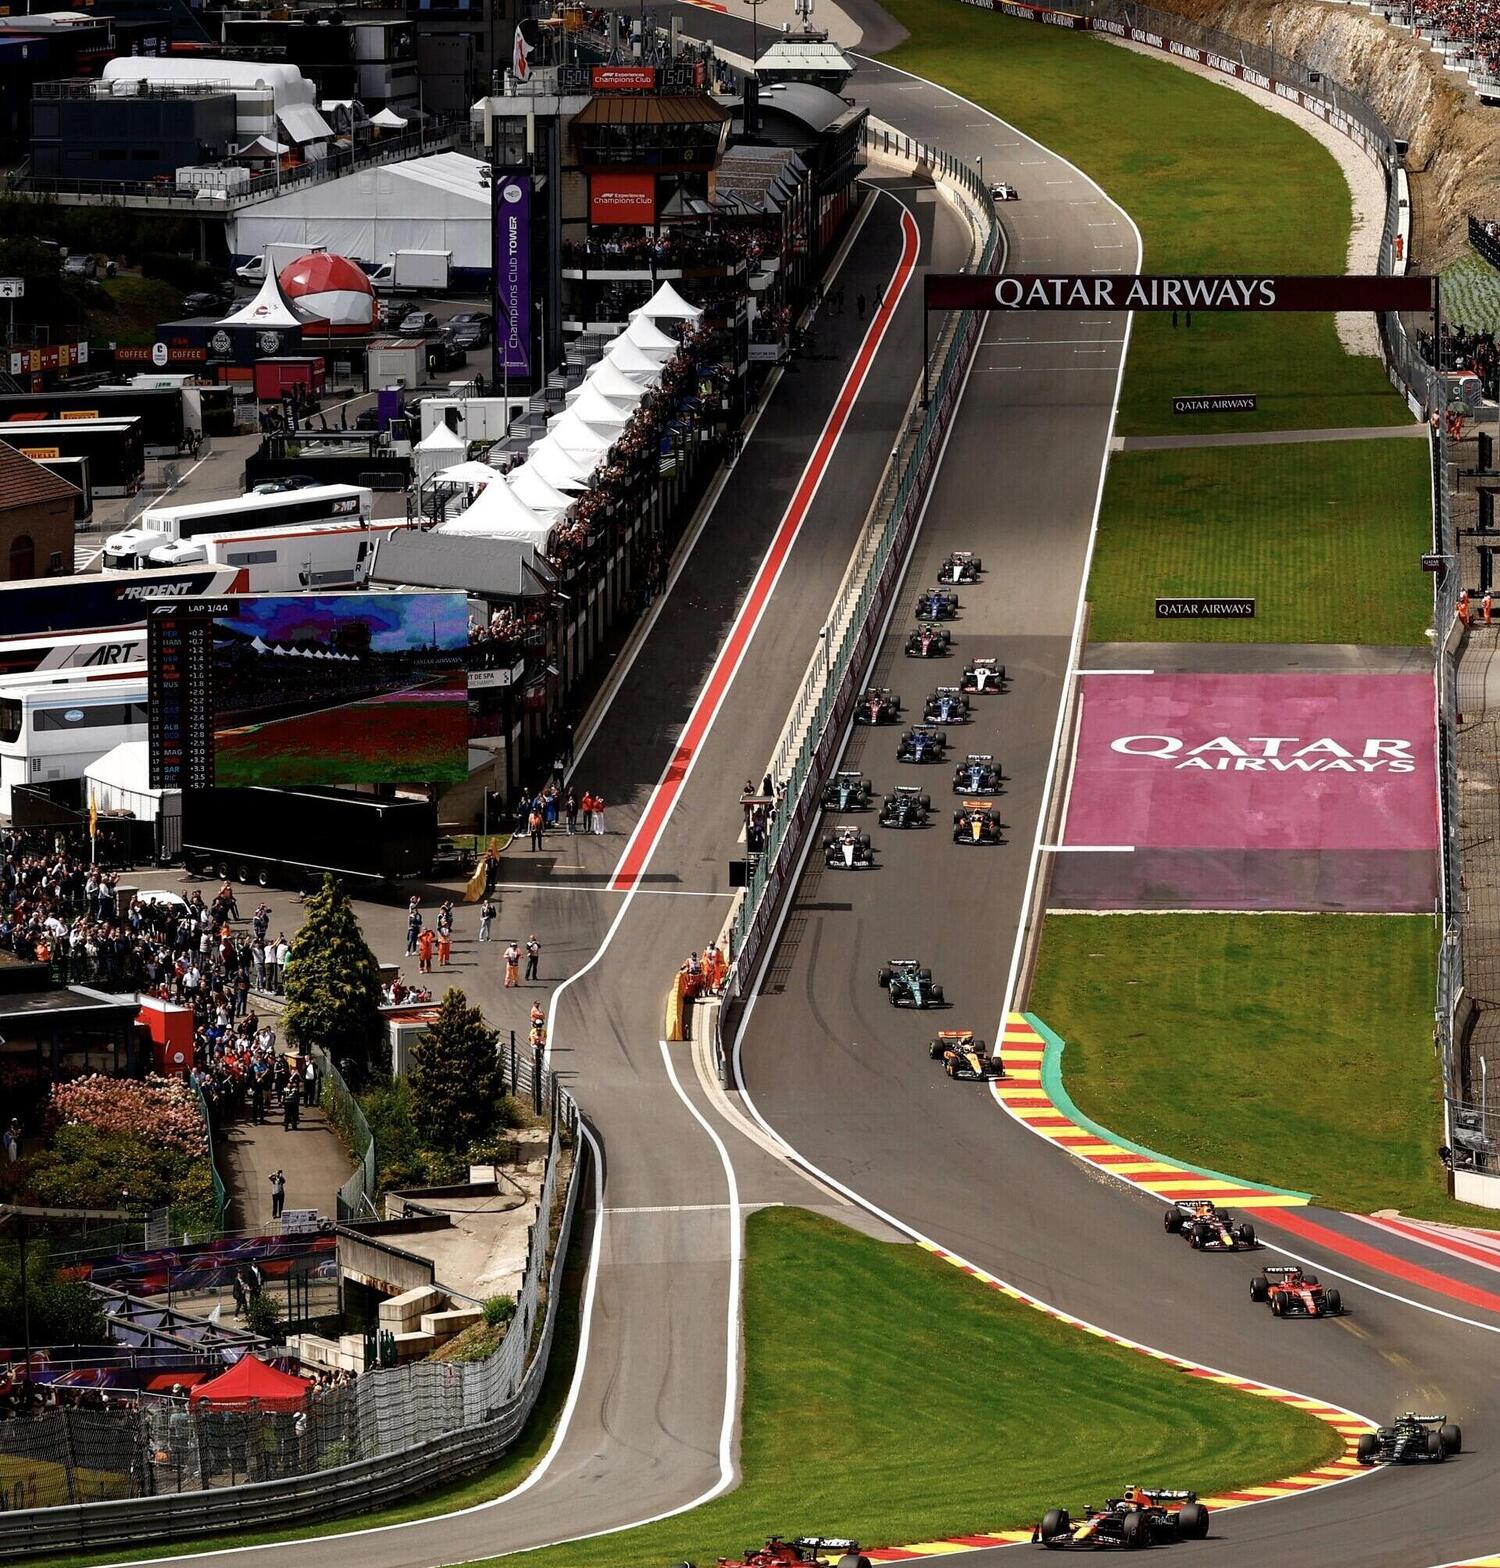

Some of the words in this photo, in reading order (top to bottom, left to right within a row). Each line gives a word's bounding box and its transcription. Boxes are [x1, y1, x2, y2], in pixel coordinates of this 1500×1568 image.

[1093, 18, 1108, 31] QATAR
[1131, 28, 1146, 42] QATAR
[594, 76, 634, 85] Champions
[662, 70, 693, 85] 15:04
[593, 197, 634, 205] Champions
[509, 216, 518, 255] TOWER
[508, 257, 518, 283] Club
[995, 278, 1114, 309] QATAR
[1125, 278, 1276, 306] AIRWAYS
[508, 284, 519, 349] Champions
[1175, 401, 1209, 413] QATAR
[1211, 398, 1255, 411] AIRWAYS
[207, 604, 229, 612] 1/44
[1158, 604, 1199, 615] QATAR
[1201, 604, 1252, 614] AIRWAYS
[82, 643, 140, 667] ART
[1110, 735, 1415, 760] QATAR
[1174, 757, 1416, 773] AIRWAYS
